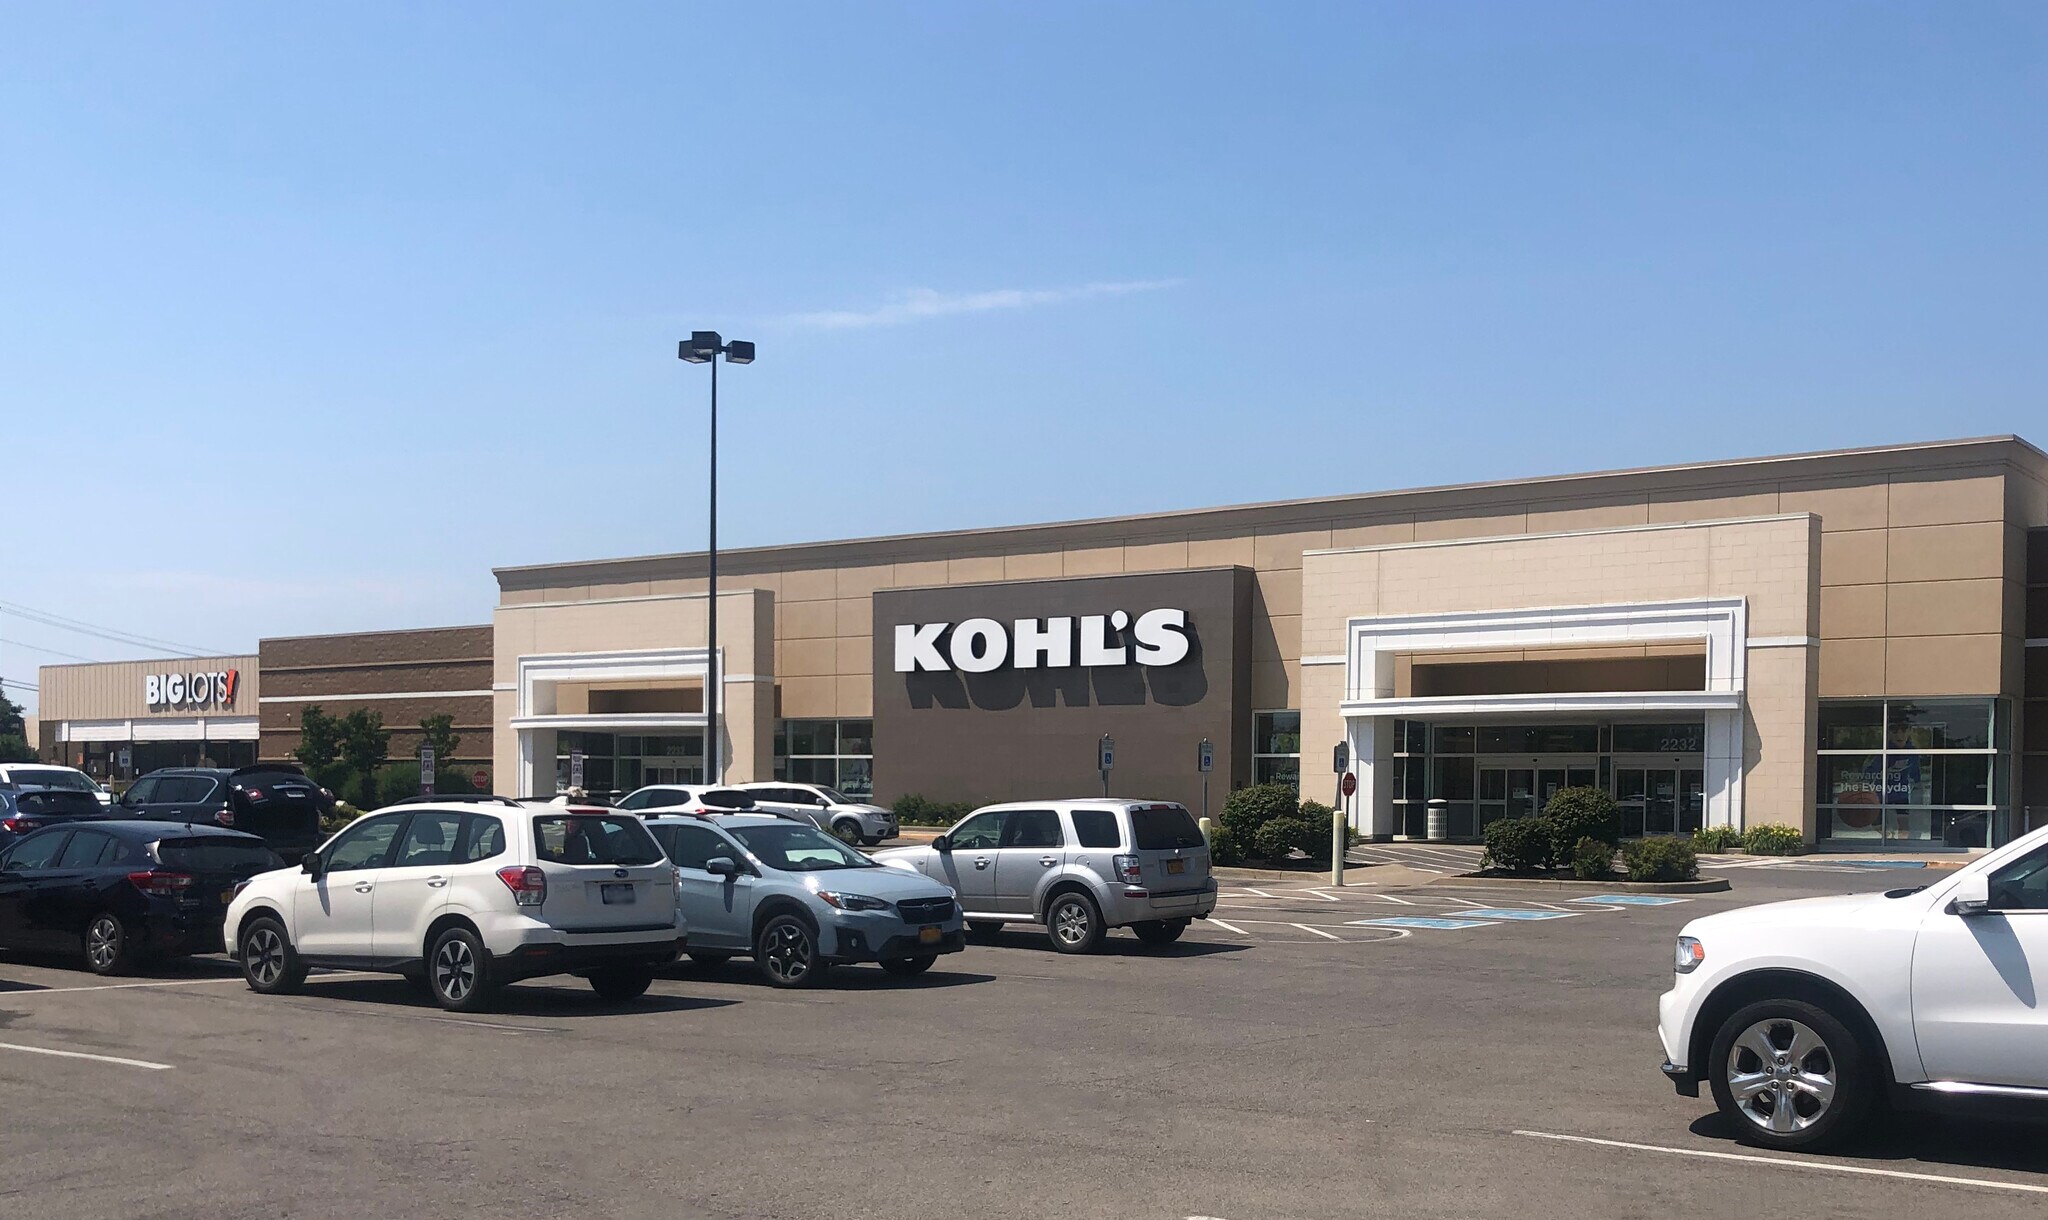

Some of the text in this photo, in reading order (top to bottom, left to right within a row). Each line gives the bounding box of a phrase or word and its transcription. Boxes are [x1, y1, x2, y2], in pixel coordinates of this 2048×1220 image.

[894, 608, 1190, 673] KOHL'S
[1660, 738, 1697, 751] 2232
[1841, 771, 1901, 782] Rewardng
[1343, 780, 1356, 789] STOP
[1840, 783, 1914, 794] the Eveyday
